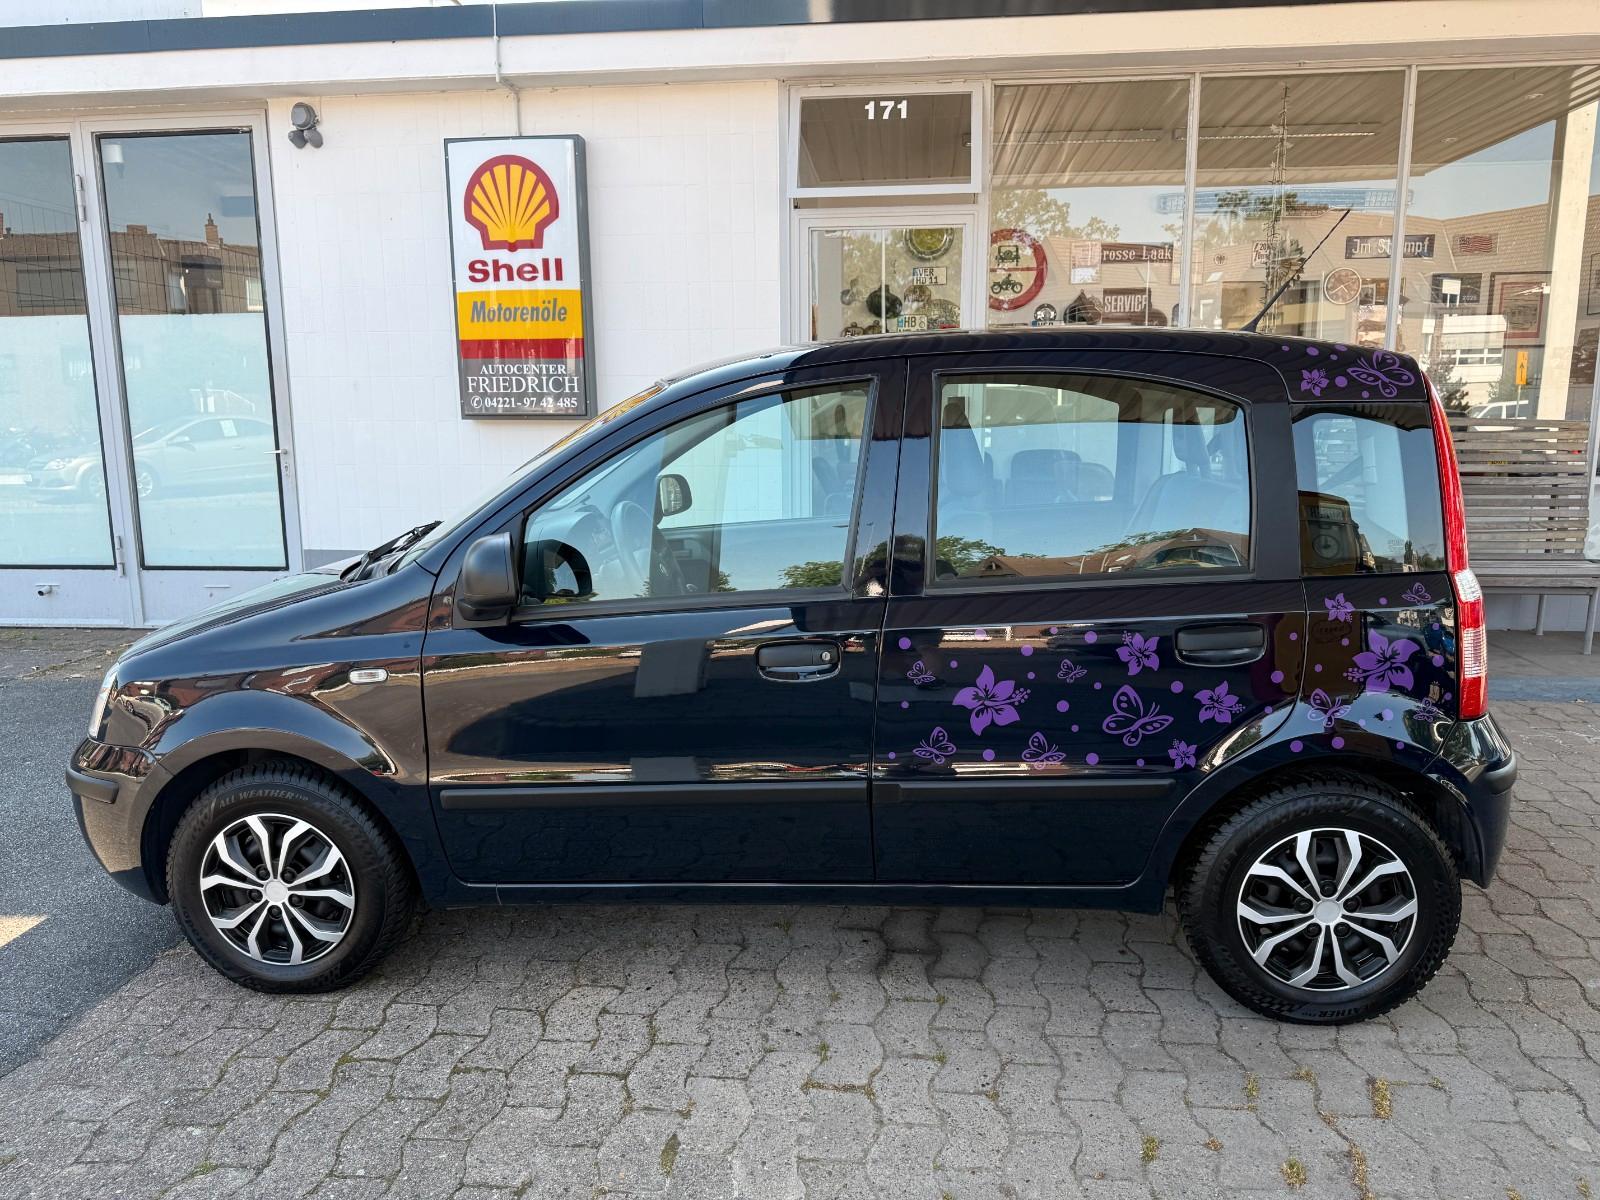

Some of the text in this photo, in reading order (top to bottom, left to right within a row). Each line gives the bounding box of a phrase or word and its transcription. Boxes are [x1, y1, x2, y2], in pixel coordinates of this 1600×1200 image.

[864, 99, 908, 120] 171
[468, 257, 564, 283] Shell
[470, 298, 567, 323] Motorenöle
[904, 316, 917, 328] HB
[480, 364, 567, 375] AUTOCENTER
[467, 376, 580, 393] FRIEDRICH
[523, 398, 537, 408] 97
[540, 398, 554, 408] 42
[557, 397, 578, 408] 485
[239, 789, 294, 801] WEATHER
